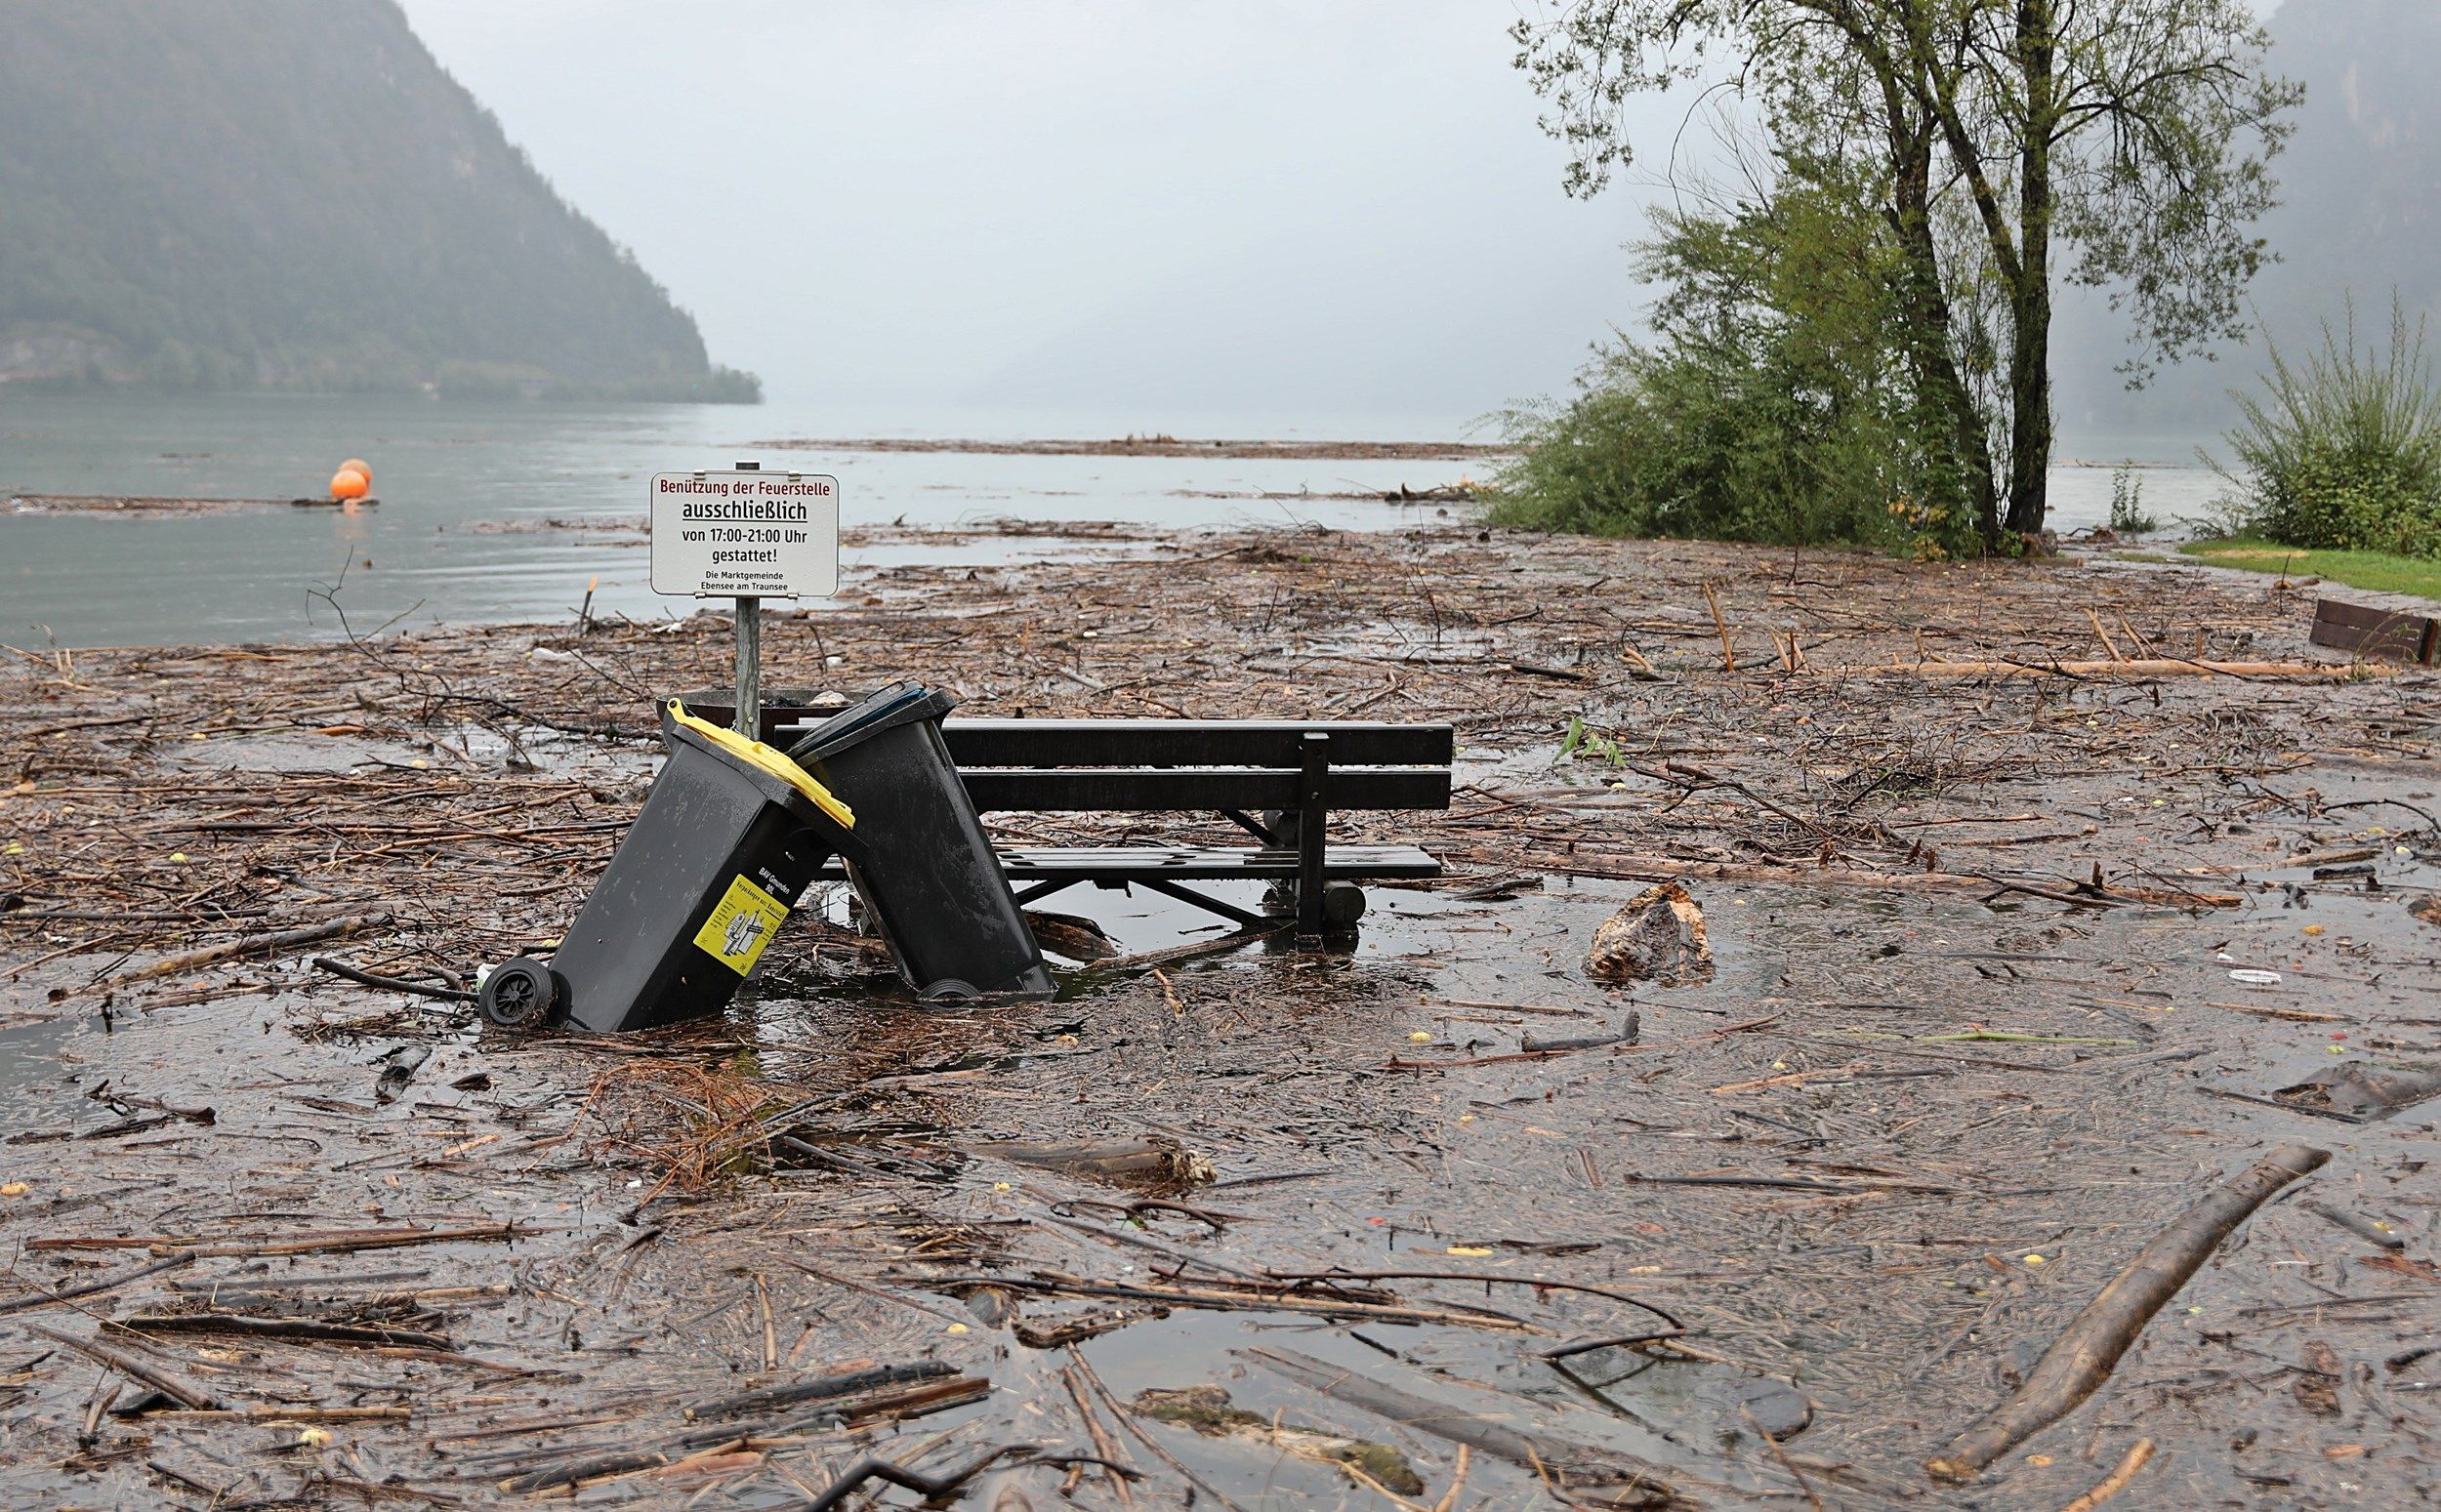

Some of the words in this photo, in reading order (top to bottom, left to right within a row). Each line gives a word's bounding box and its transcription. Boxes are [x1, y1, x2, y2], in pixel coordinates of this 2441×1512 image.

[660, 479, 728, 497] Benützung
[733, 481, 754, 495] der
[759, 481, 830, 496] Feuerstelle
[683, 500, 807, 520] ausschließlich
[683, 530, 706, 542] von
[710, 528, 781, 543] 17:00-21:00
[785, 529, 807, 544] Uhr
[712, 549, 777, 564] gestattet!
[705, 571, 719, 580] Die
[722, 571, 784, 581] Marktgemeinde
[701, 582, 733, 591] Ebensee
[752, 582, 788, 591] Traunsee
[759, 867, 771, 879] BAV
[768, 875, 790, 894] Gmunden
